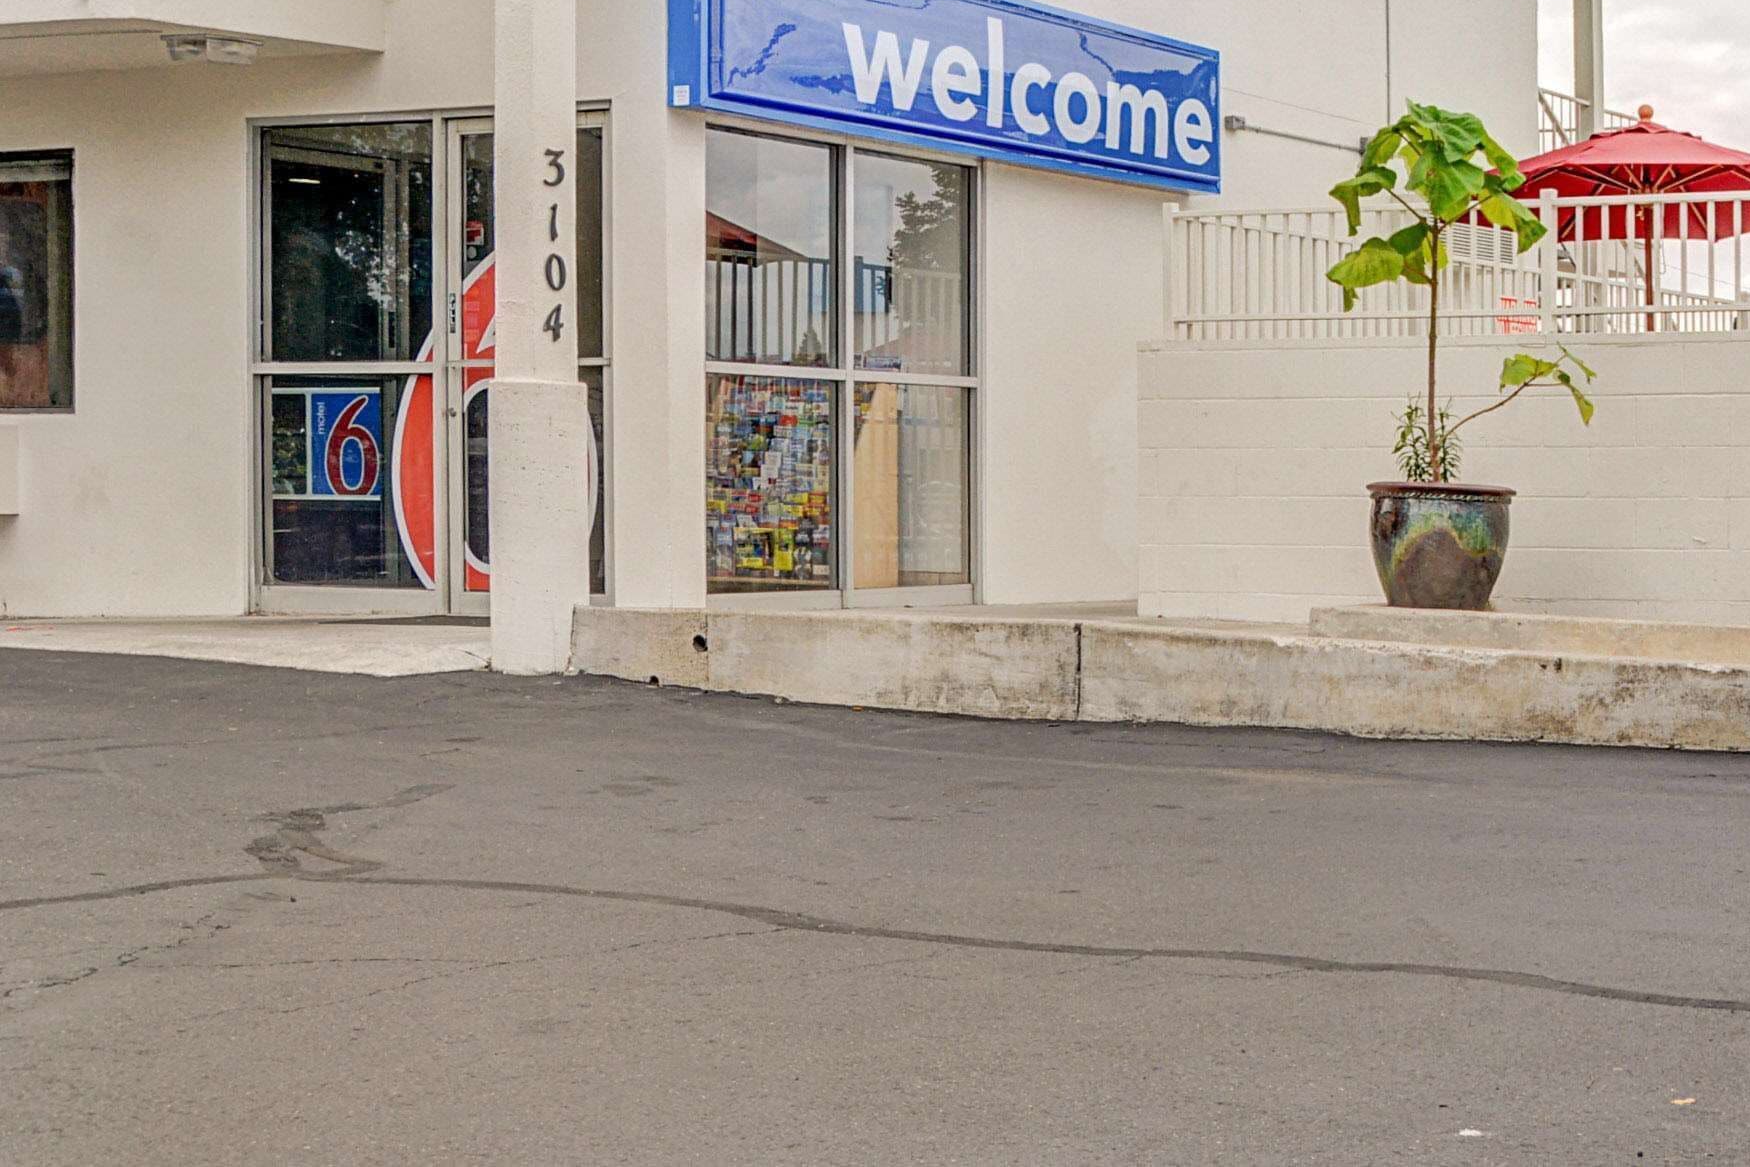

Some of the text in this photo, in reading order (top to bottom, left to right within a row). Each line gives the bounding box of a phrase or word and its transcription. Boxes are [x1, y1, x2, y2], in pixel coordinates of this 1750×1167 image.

[841, 16, 1213, 166] welcome
[543, 148, 567, 342] 3104
[316, 394, 380, 496] motel 6
